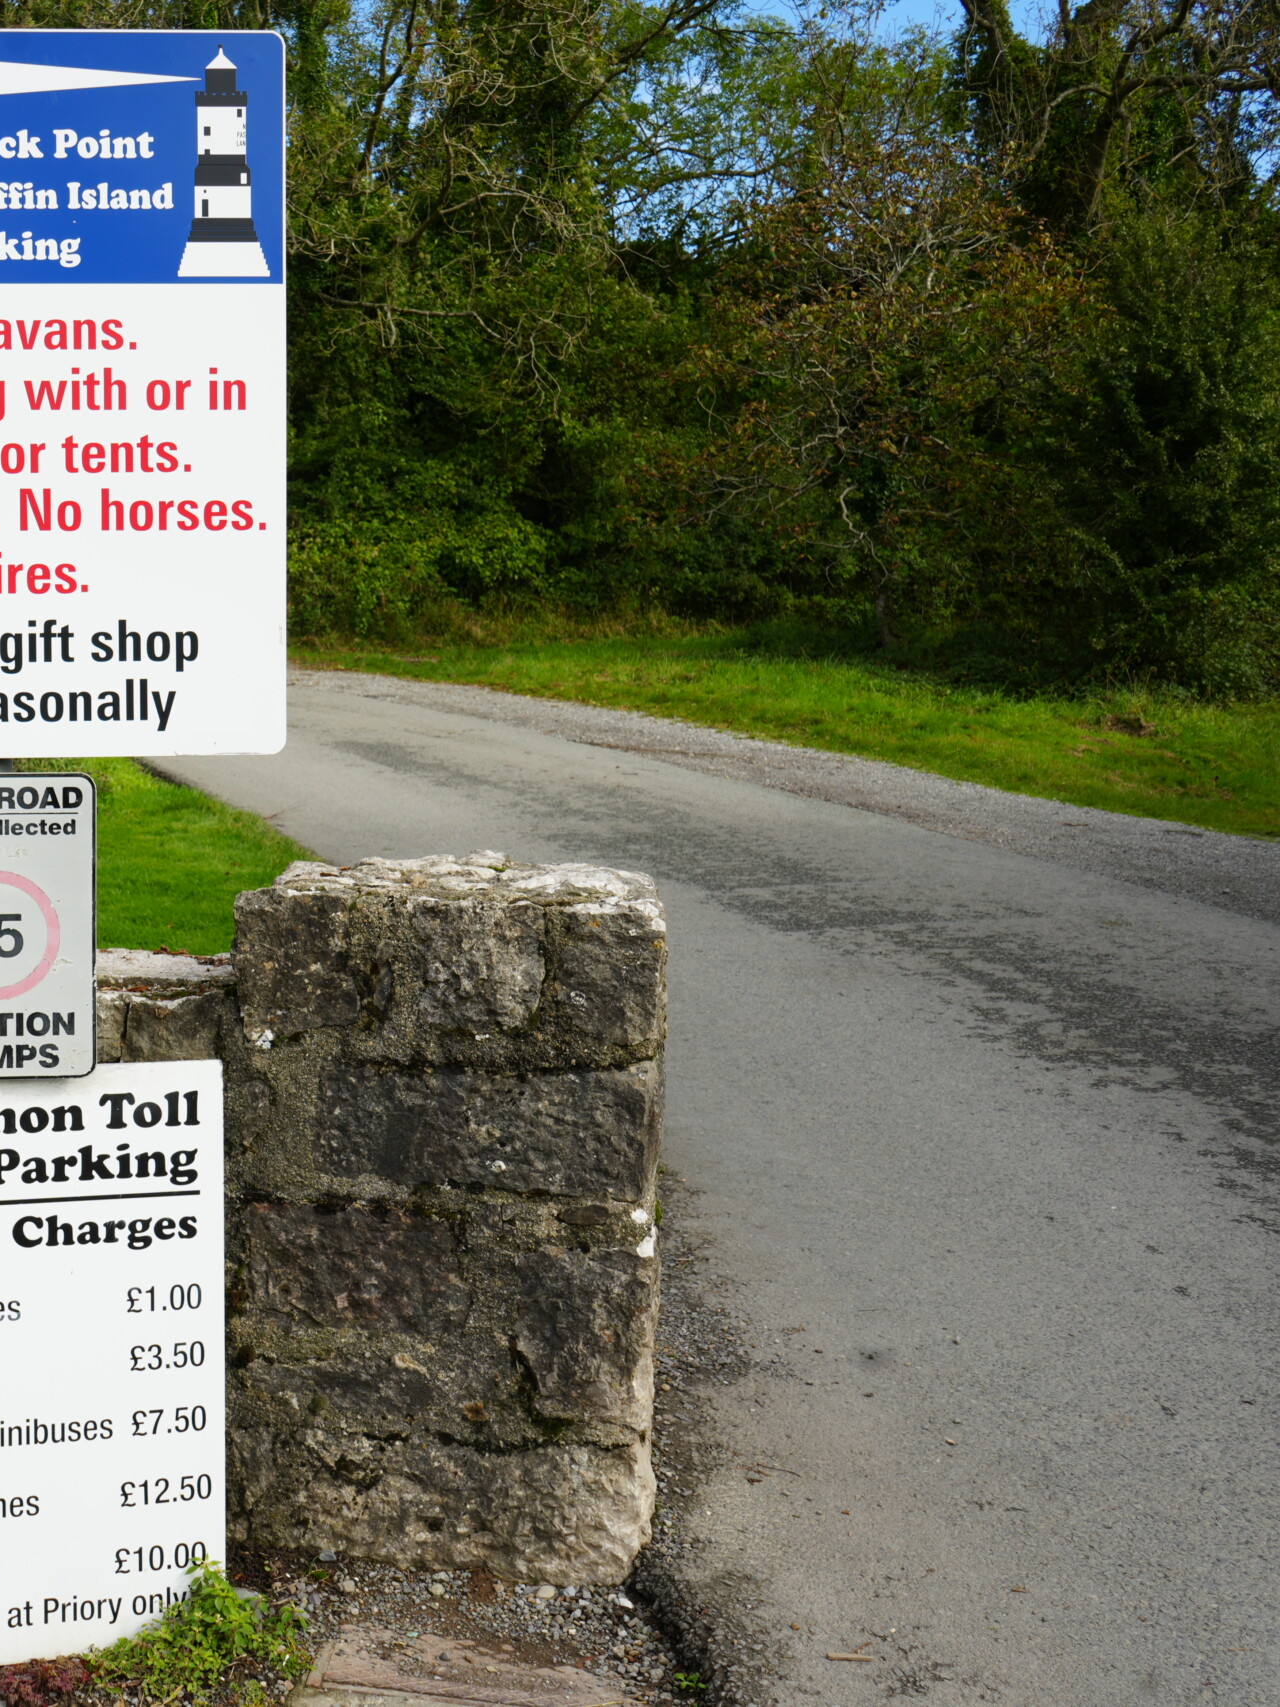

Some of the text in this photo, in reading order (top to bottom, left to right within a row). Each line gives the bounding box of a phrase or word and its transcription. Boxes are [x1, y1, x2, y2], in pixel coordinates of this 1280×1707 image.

[53, 129, 154, 158] Point
[67, 182, 174, 209] Island
[24, 368, 126, 410] with
[147, 380, 191, 410] or
[210, 368, 246, 410] in
[1, 443, 45, 474] or
[62, 435, 191, 473] tents.
[20, 489, 81, 531] No
[102, 488, 266, 531] horses.
[0, 620, 74, 674] gift
[92, 620, 198, 672] shop
[99, 1091, 200, 1129] Toll
[13, 1215, 197, 1250] Charges
[127, 1284, 201, 1312] £1.00
[131, 1341, 204, 1371] £3.50
[133, 1406, 206, 1436] £7.50
[121, 1474, 211, 1507] £12.50
[115, 1542, 206, 1574] £10.00
[8, 1602, 32, 1627] at
[44, 1596, 121, 1624] Priory
